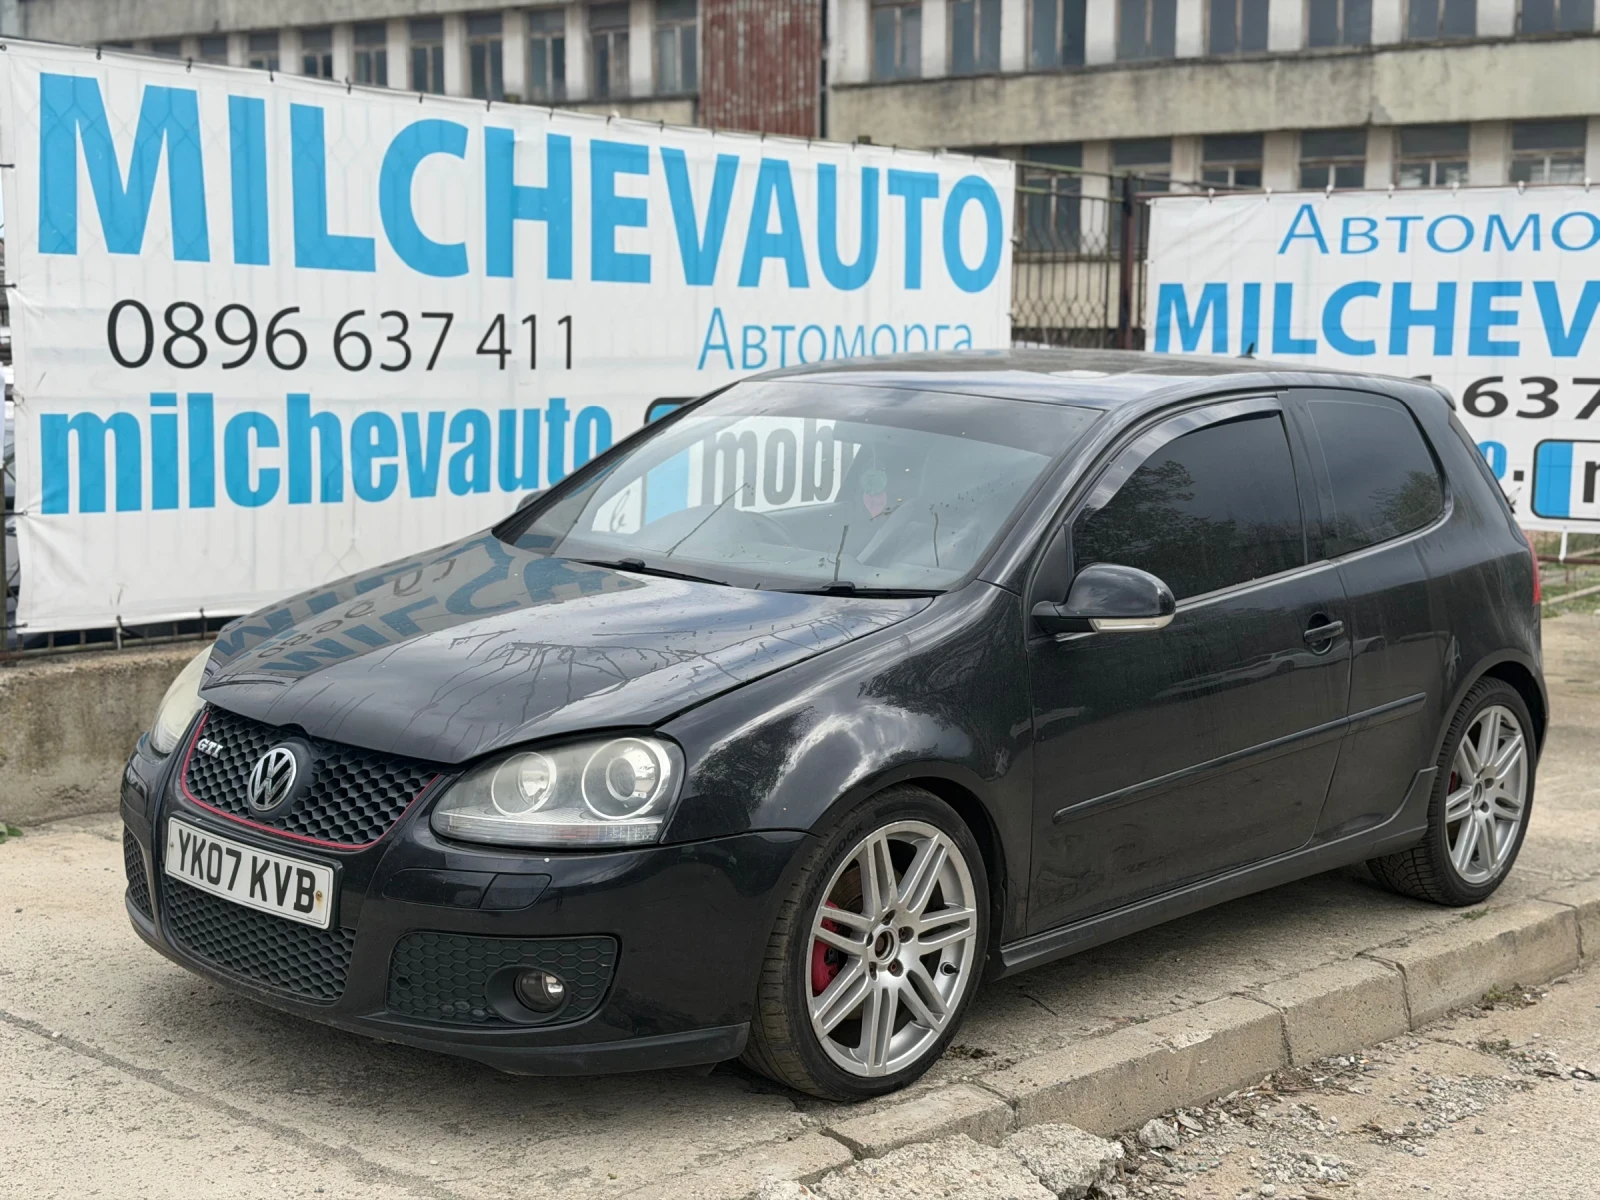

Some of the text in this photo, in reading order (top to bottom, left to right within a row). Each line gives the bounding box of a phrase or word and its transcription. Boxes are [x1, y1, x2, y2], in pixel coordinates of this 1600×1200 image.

[38, 72, 1003, 293] MILCHEVAUTO
[1277, 204, 1600, 254] Автомо
[106, 299, 573, 371] 0896 637 411
[1154, 280, 1600, 357] MILCHEV
[1462, 376, 1600, 419] 637
[40, 392, 612, 514] milchevauto
[198, 738, 224, 758] GTI
[250, 747, 297, 812] VW
[178, 828, 316, 914] YK07 KVB
